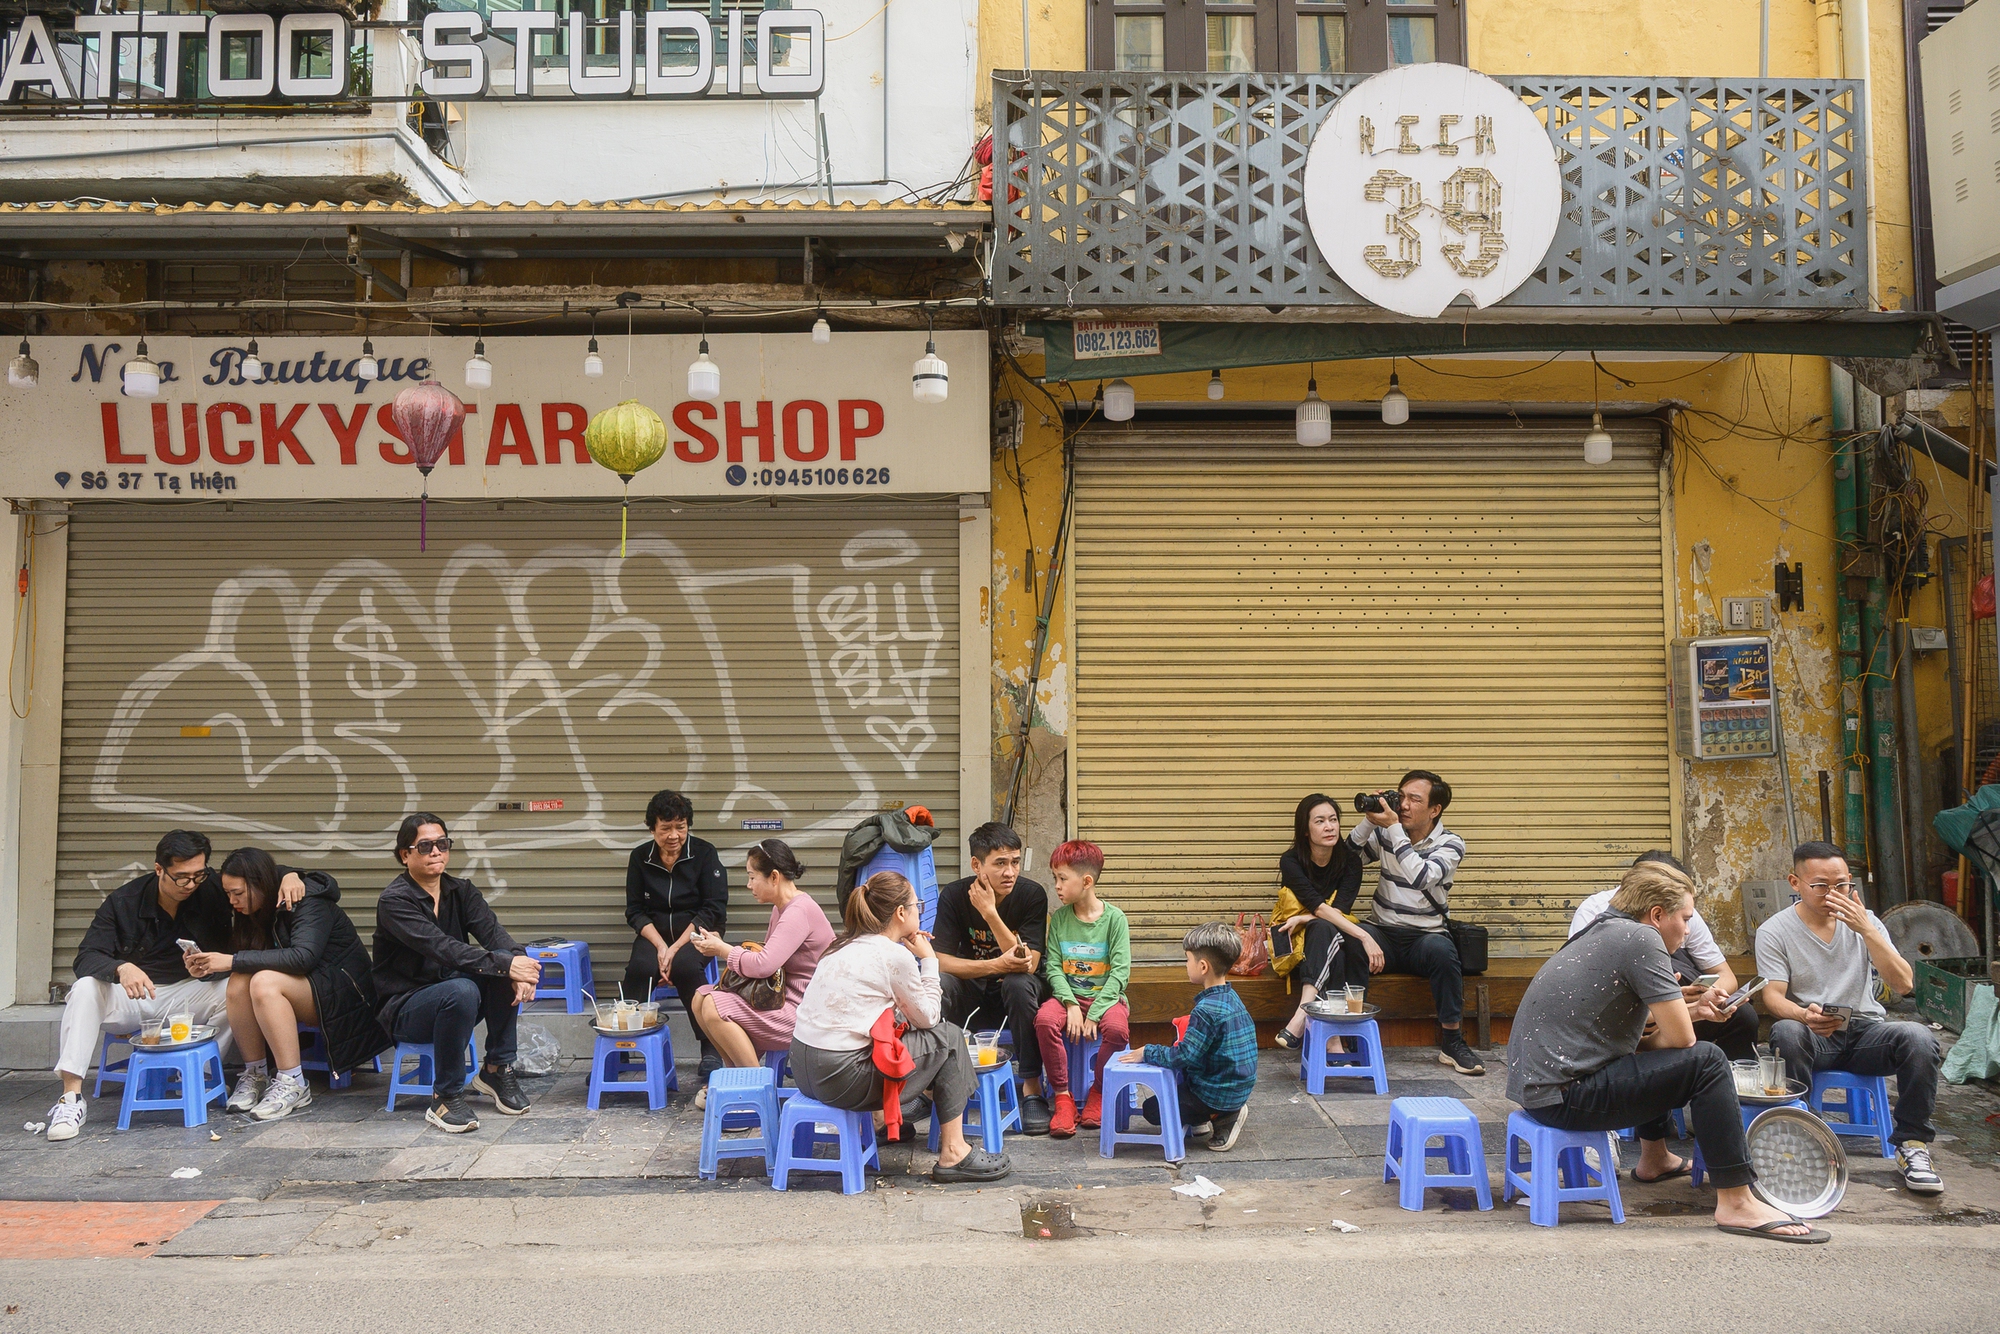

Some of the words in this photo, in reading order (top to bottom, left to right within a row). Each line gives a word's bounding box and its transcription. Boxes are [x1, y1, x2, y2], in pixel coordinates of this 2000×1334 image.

[0, 13, 350, 100] ATTOO
[421, 10, 825, 99] STUDIO
[1363, 167, 1508, 279] 39
[1076, 329, 1157, 352] 0982.123.662
[672, 399, 885, 463] SHOP
[118, 472, 143, 490] 37
[154, 472, 181, 495] Tạ
